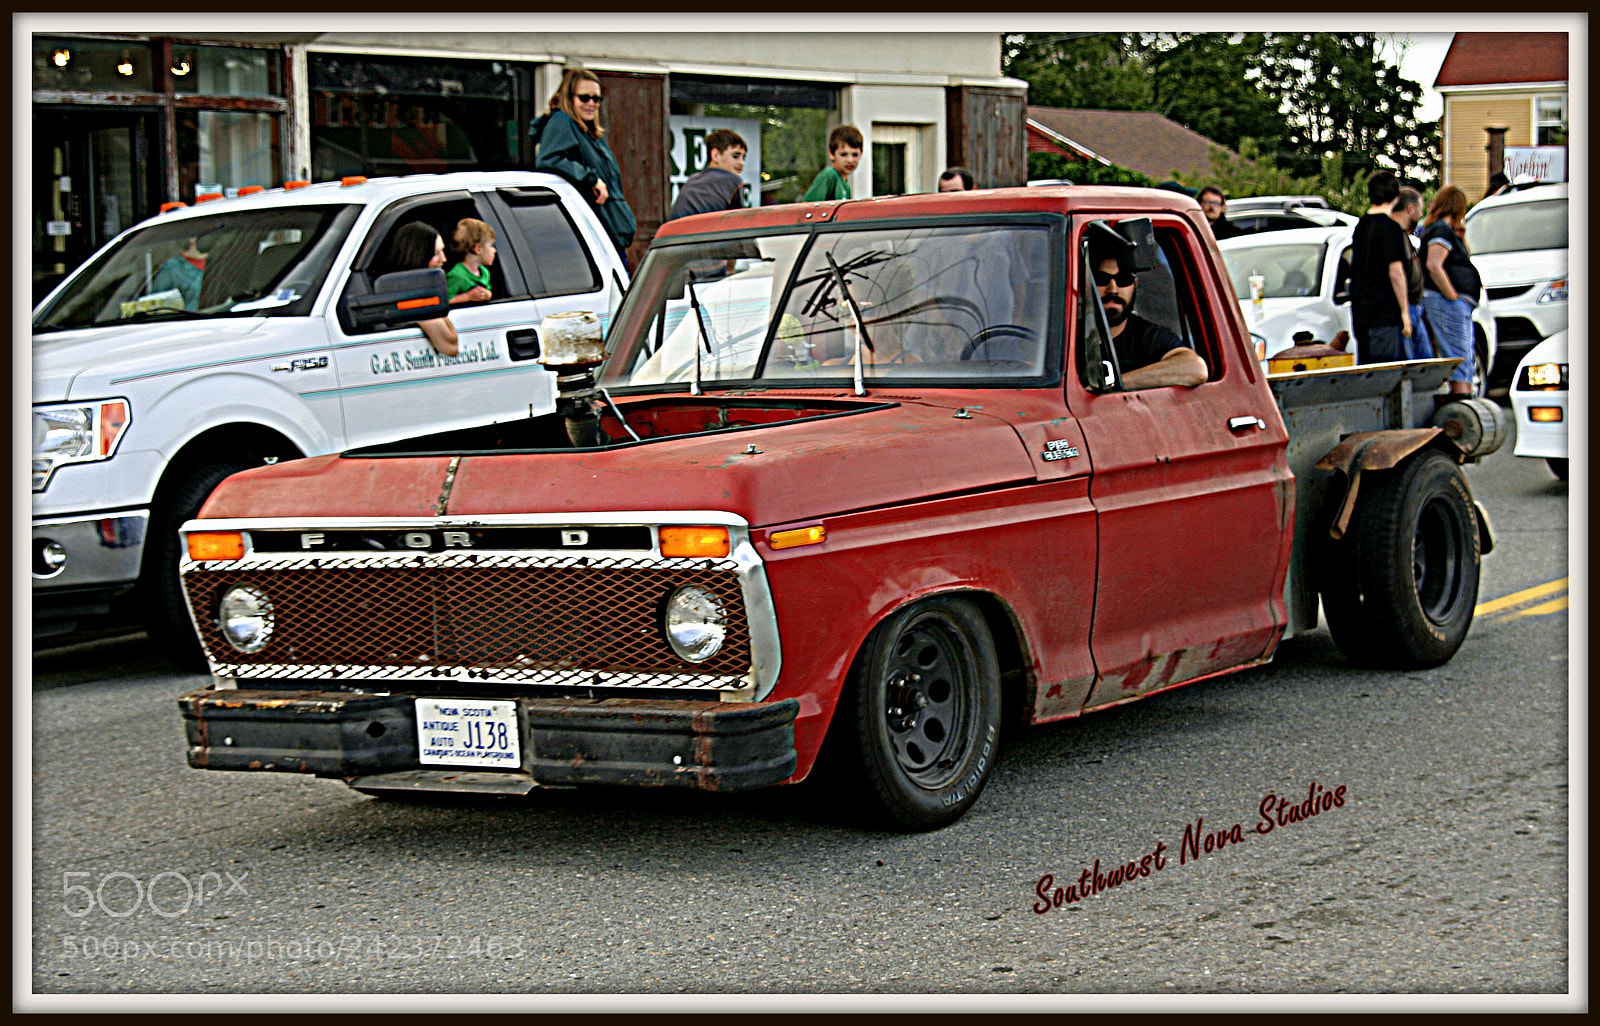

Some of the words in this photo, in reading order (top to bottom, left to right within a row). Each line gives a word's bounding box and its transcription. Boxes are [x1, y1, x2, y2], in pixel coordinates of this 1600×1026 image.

[404, 346, 435, 371] Smith
[439, 707, 459, 716] NOVA
[462, 708, 492, 717] SCOTIA
[423, 721, 459, 731] ANTIQUE
[463, 721, 508, 750] J138
[431, 737, 455, 747] AUTO
